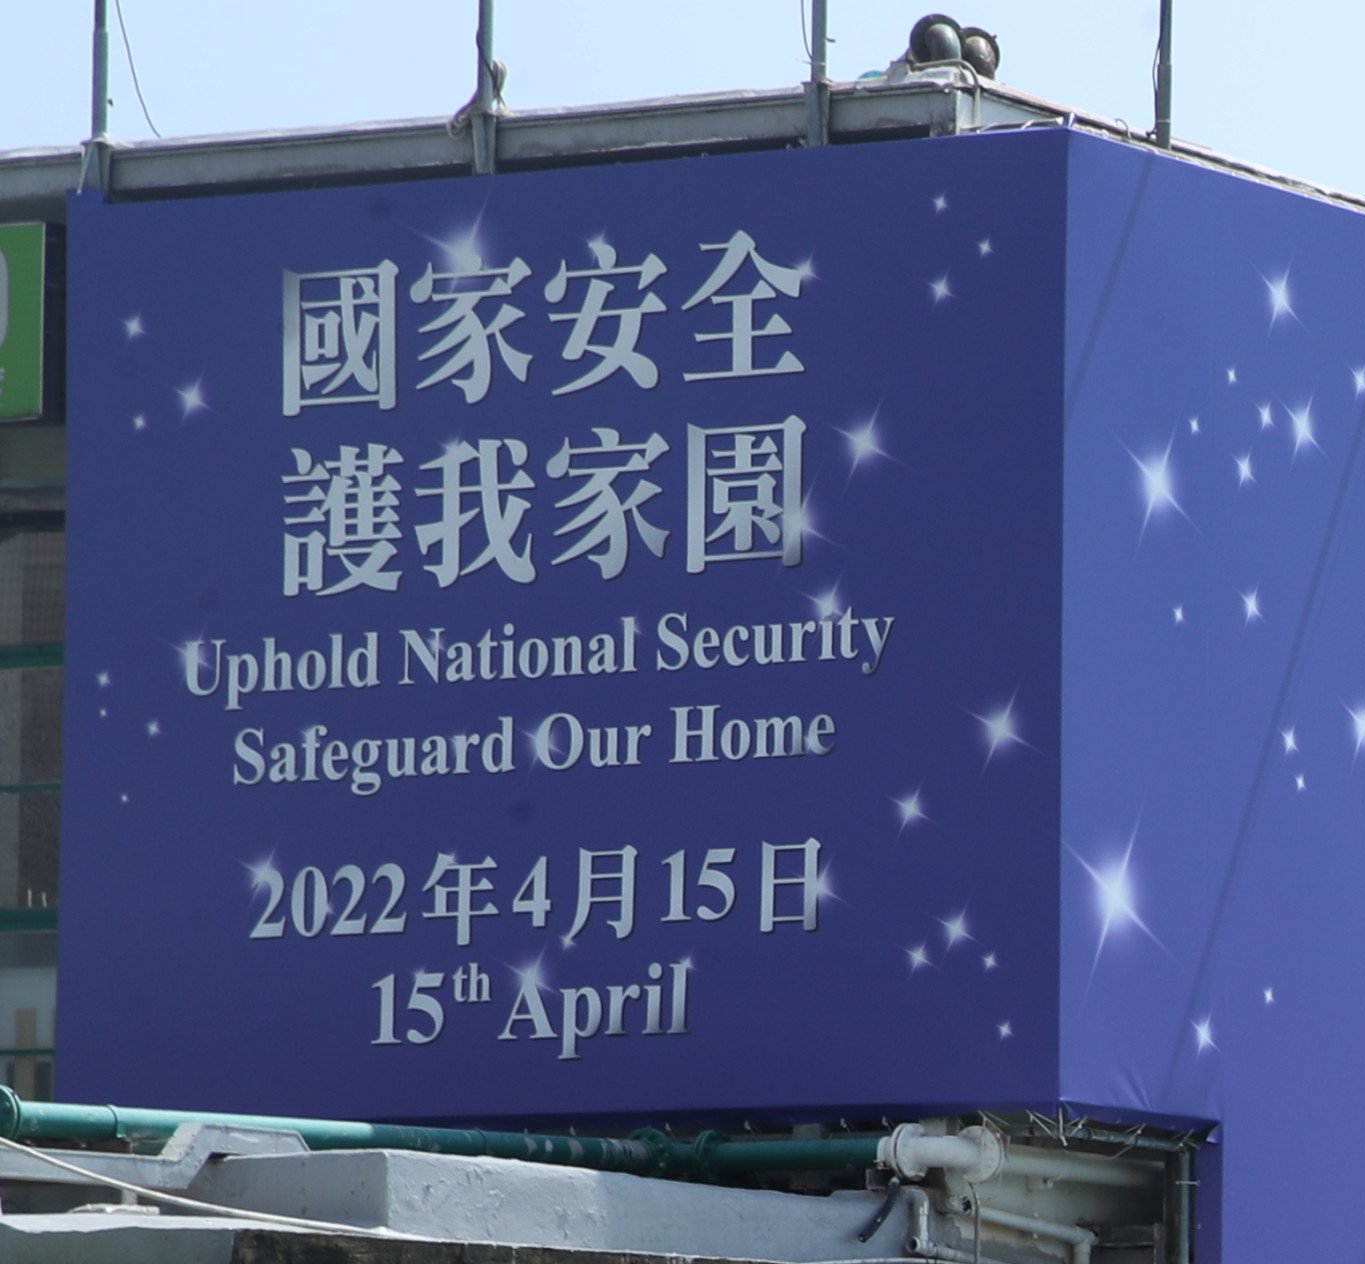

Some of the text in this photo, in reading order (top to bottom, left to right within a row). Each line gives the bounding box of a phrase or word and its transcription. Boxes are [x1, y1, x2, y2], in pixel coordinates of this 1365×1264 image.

[283, 229, 805, 417] 國家安全
[281, 414, 808, 598] 護我家園
[182, 608, 896, 710] Uphold National Security
[232, 702, 836, 795] Safeguard Our Home
[248, 836, 824, 947] 2022年4月15日
[371, 962, 692, 1060] 15th April
